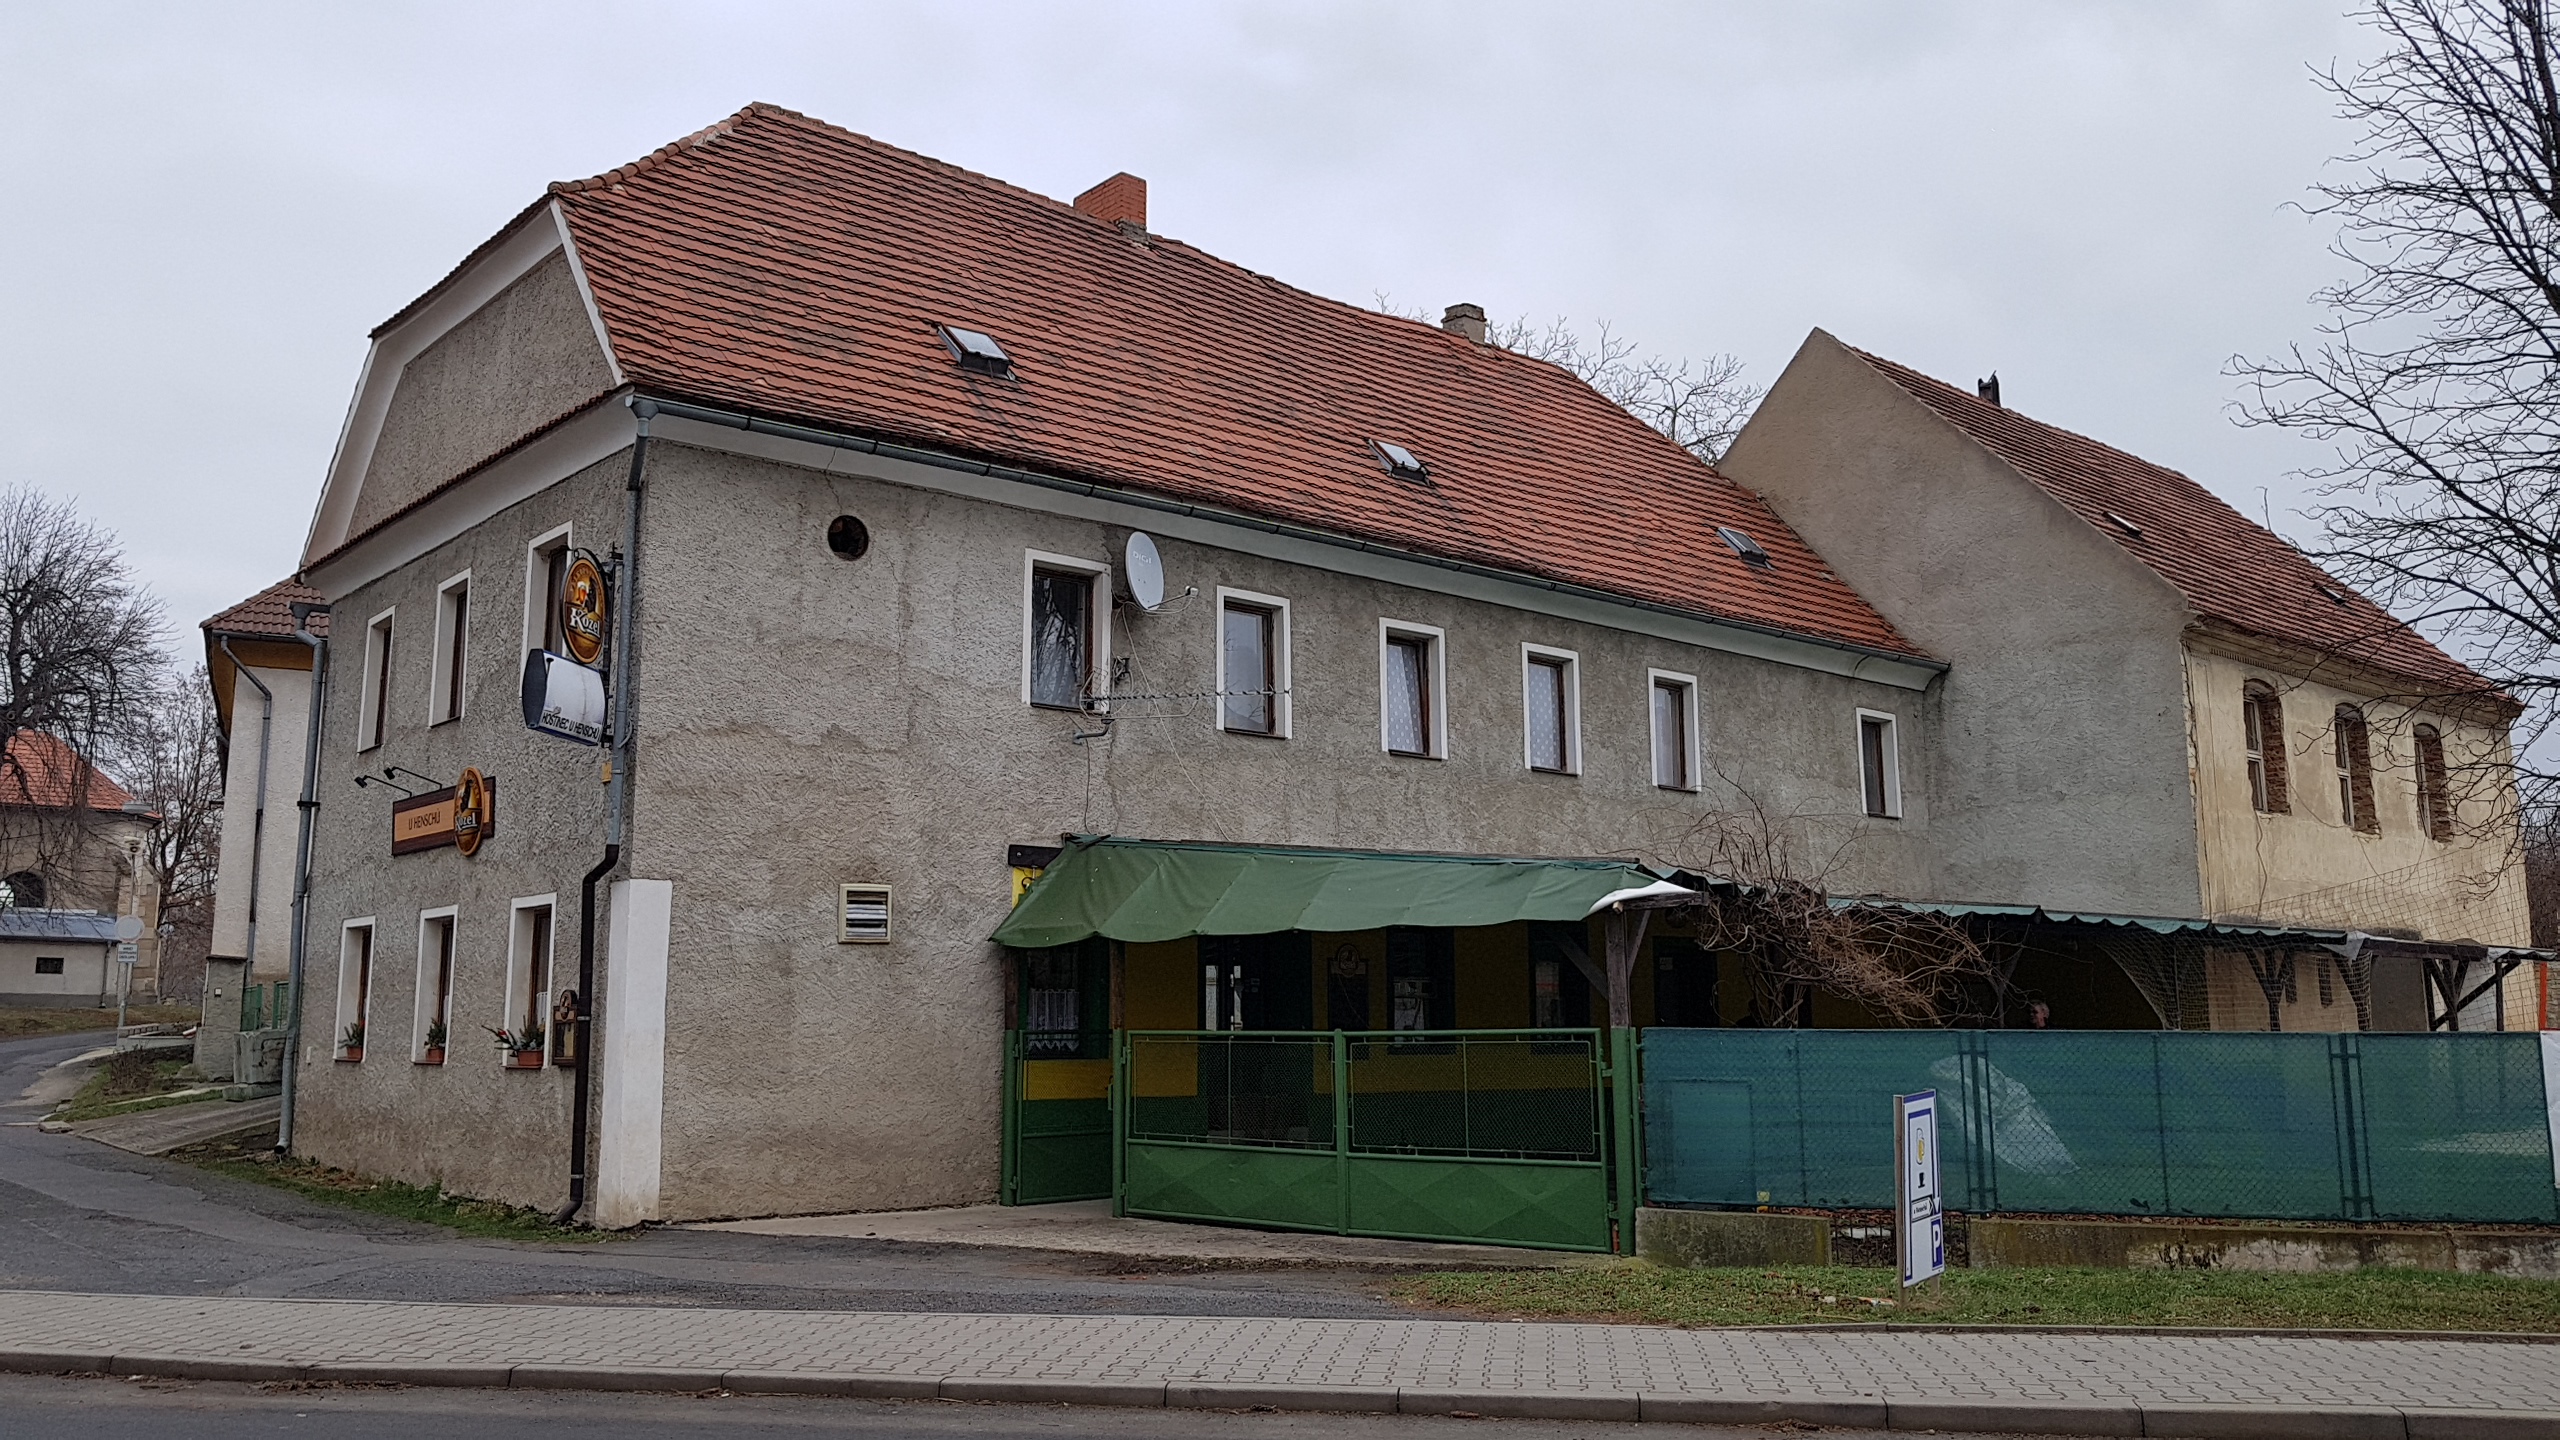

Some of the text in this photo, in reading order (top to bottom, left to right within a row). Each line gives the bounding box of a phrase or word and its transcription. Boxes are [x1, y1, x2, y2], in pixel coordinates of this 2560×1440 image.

[569, 607, 600, 637] Kozel
[541, 712, 569, 730] HOSTINEC
[568, 720, 576, 732] U
[408, 817, 413, 831] U
[1932, 1223, 1941, 1263] P
